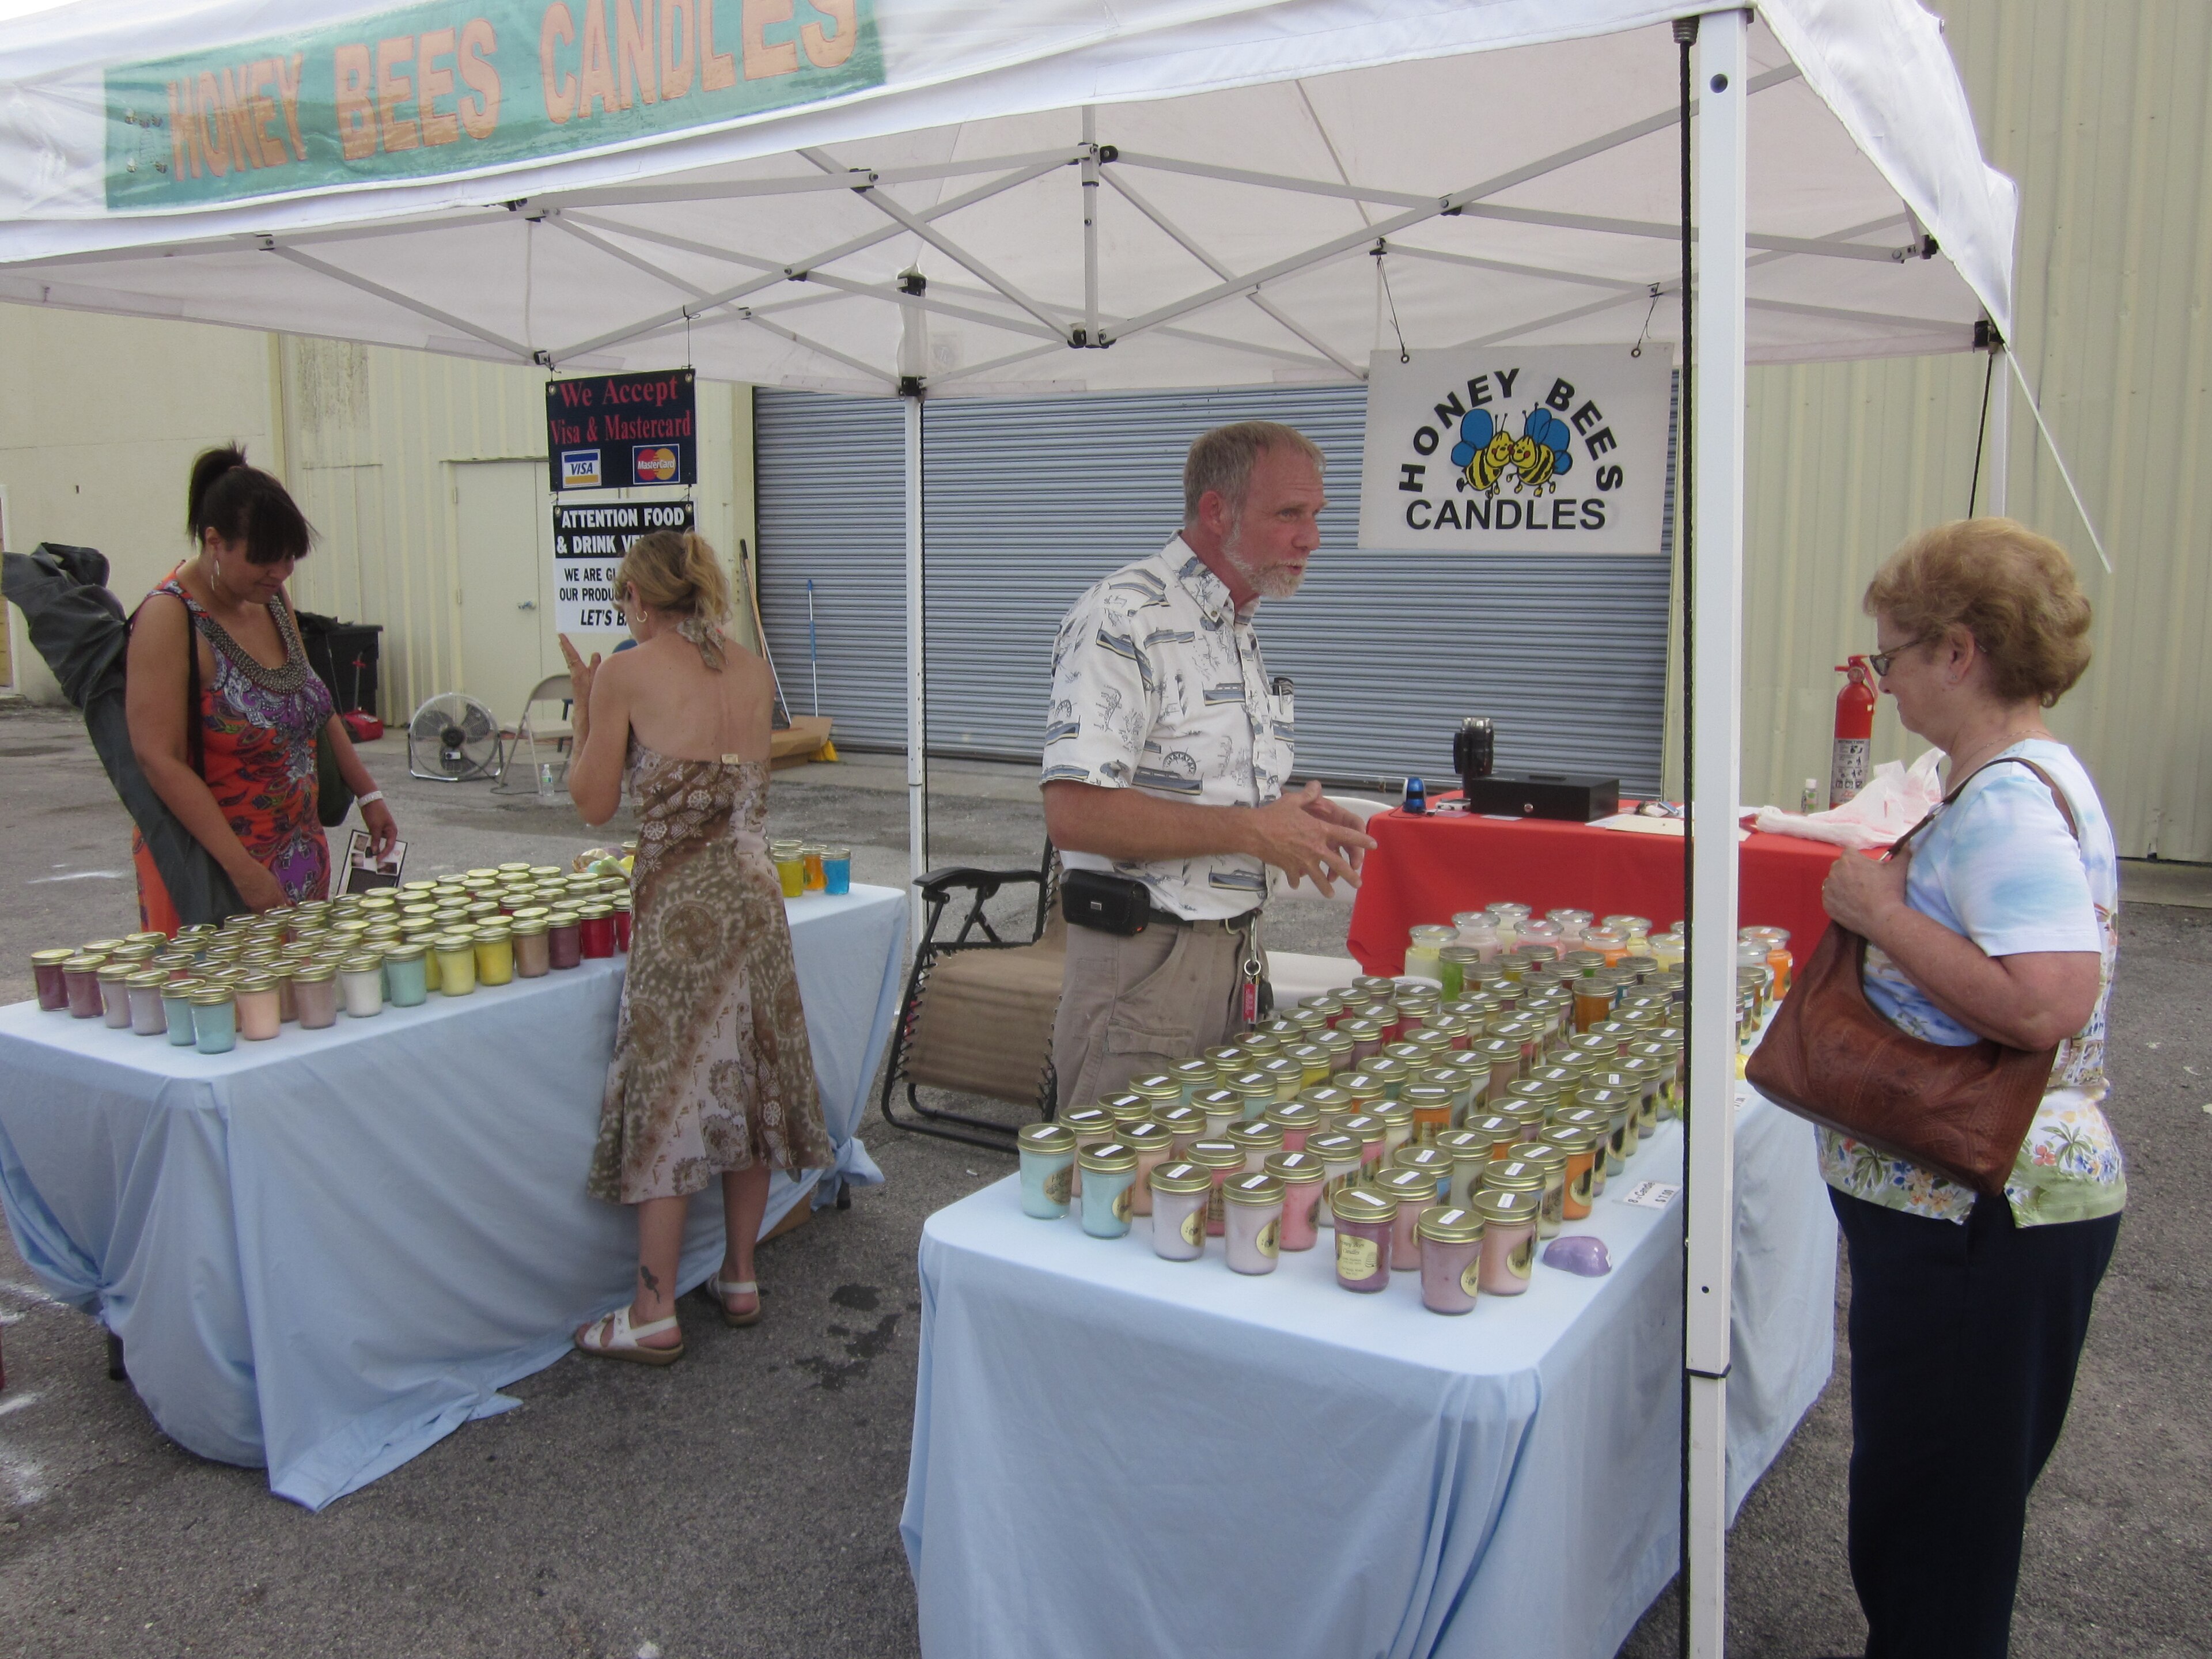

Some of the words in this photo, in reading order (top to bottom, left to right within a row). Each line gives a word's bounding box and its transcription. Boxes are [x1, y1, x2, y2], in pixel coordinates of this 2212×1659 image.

[167, 51, 308, 182] HONEY
[334, 17, 502, 161] BEES
[540, 0, 858, 124] CANDLES
[559, 381, 592, 408] We
[602, 376, 679, 407] Accept
[551, 418, 581, 445] Visa
[586, 416, 599, 442] &
[605, 410, 691, 441] Mastercard
[1399, 368, 1520, 493] HONEY
[1545, 377, 1623, 492] BEES
[570, 462, 593, 475] VISA
[637, 460, 676, 469] MasterCard
[562, 508, 638, 528] ATTENTION
[643, 507, 685, 527] FOOD
[1406, 498, 1606, 530] CANDLES
[556, 535, 567, 554] &
[573, 535, 616, 554] DRINK
[564, 568, 579, 581] WE
[584, 568, 602, 581] ARE
[559, 588, 578, 601] OUR
[582, 588, 614, 601] PRODU
[581, 609, 612, 626] LET'S
